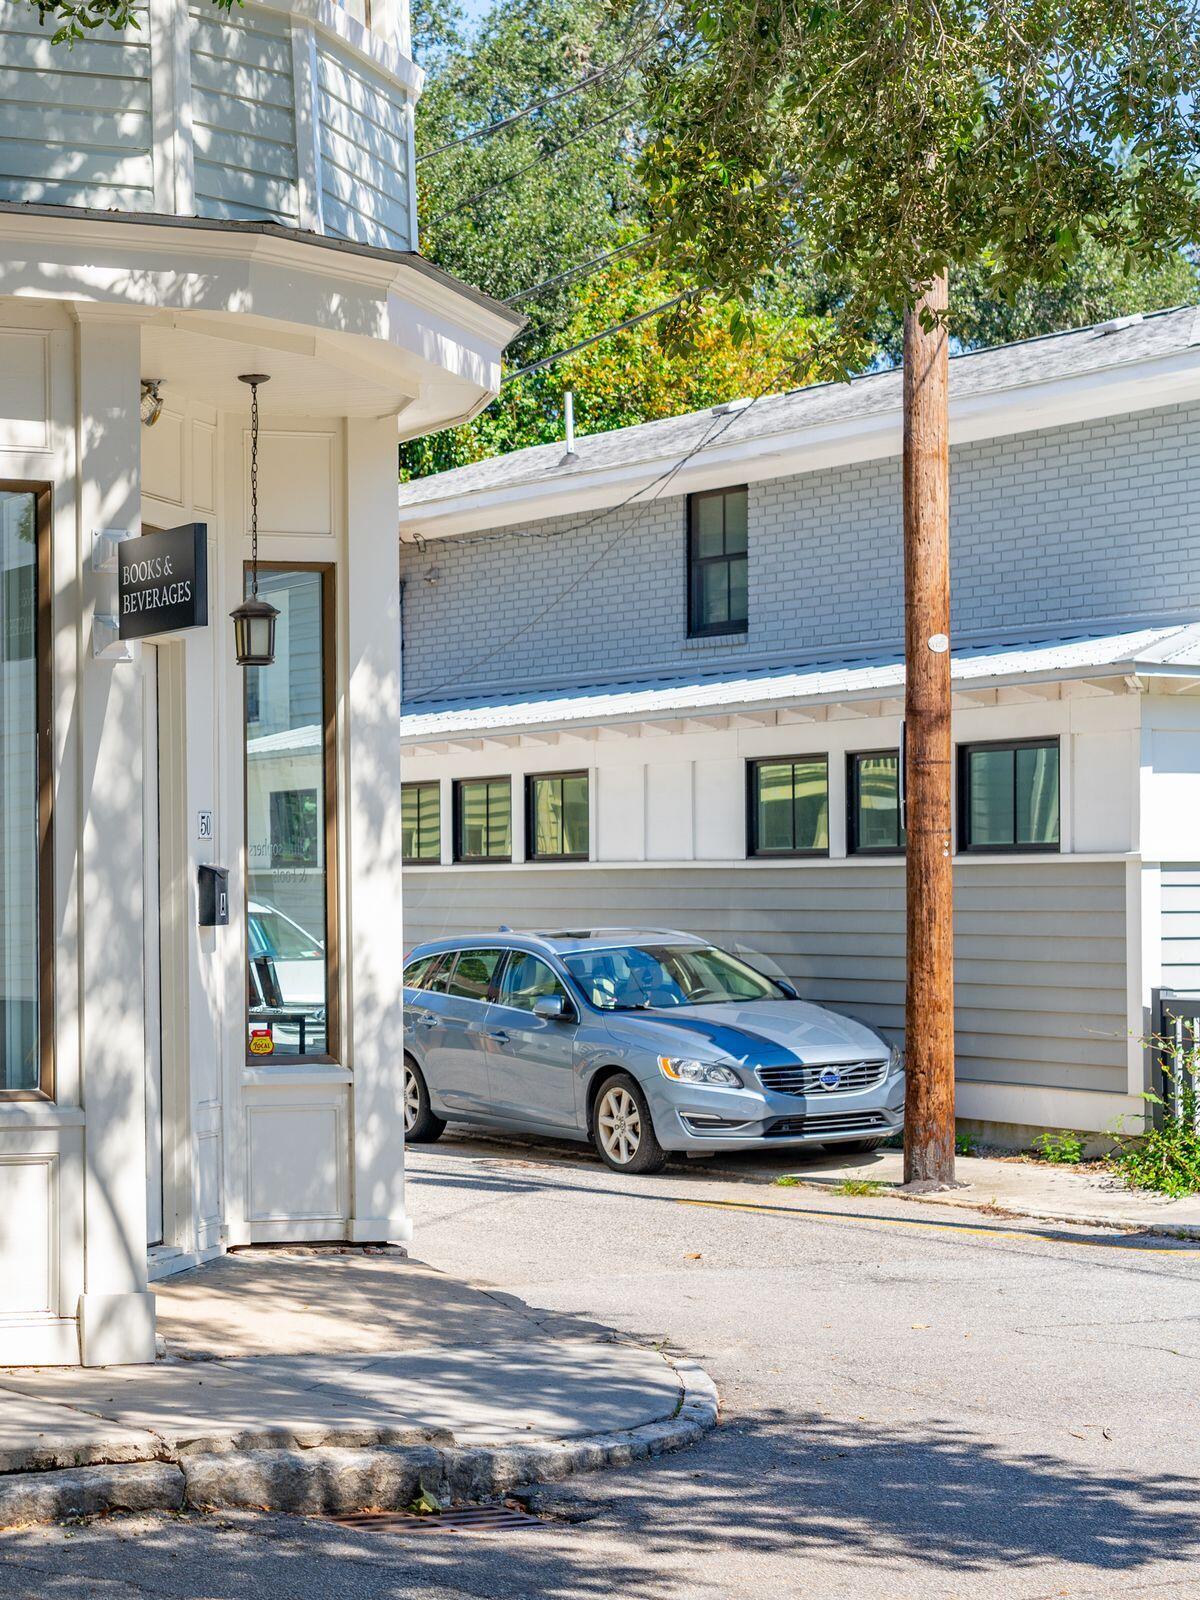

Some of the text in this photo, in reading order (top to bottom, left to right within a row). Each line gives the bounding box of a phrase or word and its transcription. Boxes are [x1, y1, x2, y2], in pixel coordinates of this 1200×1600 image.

[123, 555, 173, 585] BOOKS &
[123, 580, 191, 614] BEVERAGES
[200, 815, 211, 836] 50
